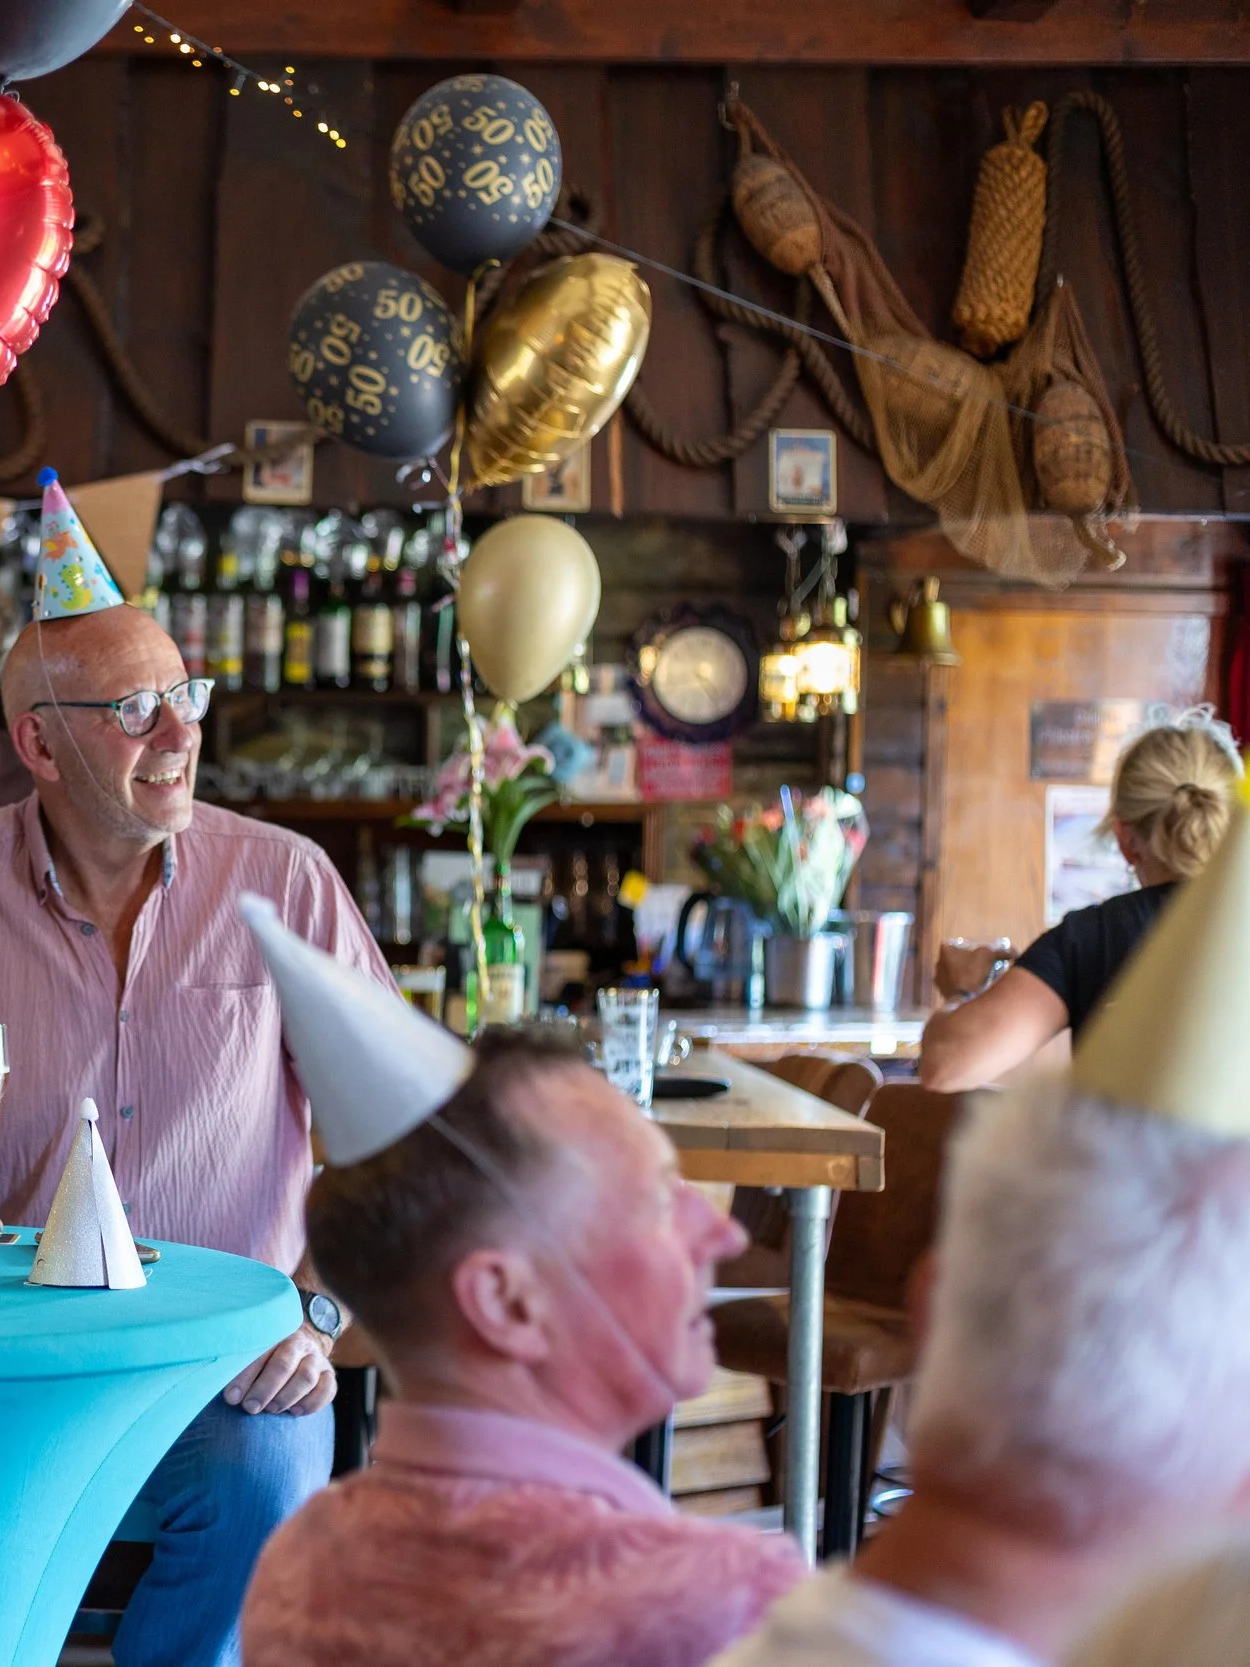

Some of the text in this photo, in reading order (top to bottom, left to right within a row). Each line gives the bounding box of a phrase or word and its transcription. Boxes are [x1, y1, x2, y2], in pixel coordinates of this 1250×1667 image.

[412, 104, 454, 151] 50
[461, 105, 516, 145] 50
[524, 107, 553, 152] 50
[407, 155, 446, 207] 50
[462, 160, 514, 206] 50
[522, 158, 554, 209] 50
[373, 289, 423, 322] 50
[319, 313, 362, 366] 50
[406, 333, 451, 379] 50
[345, 364, 386, 416] 50
